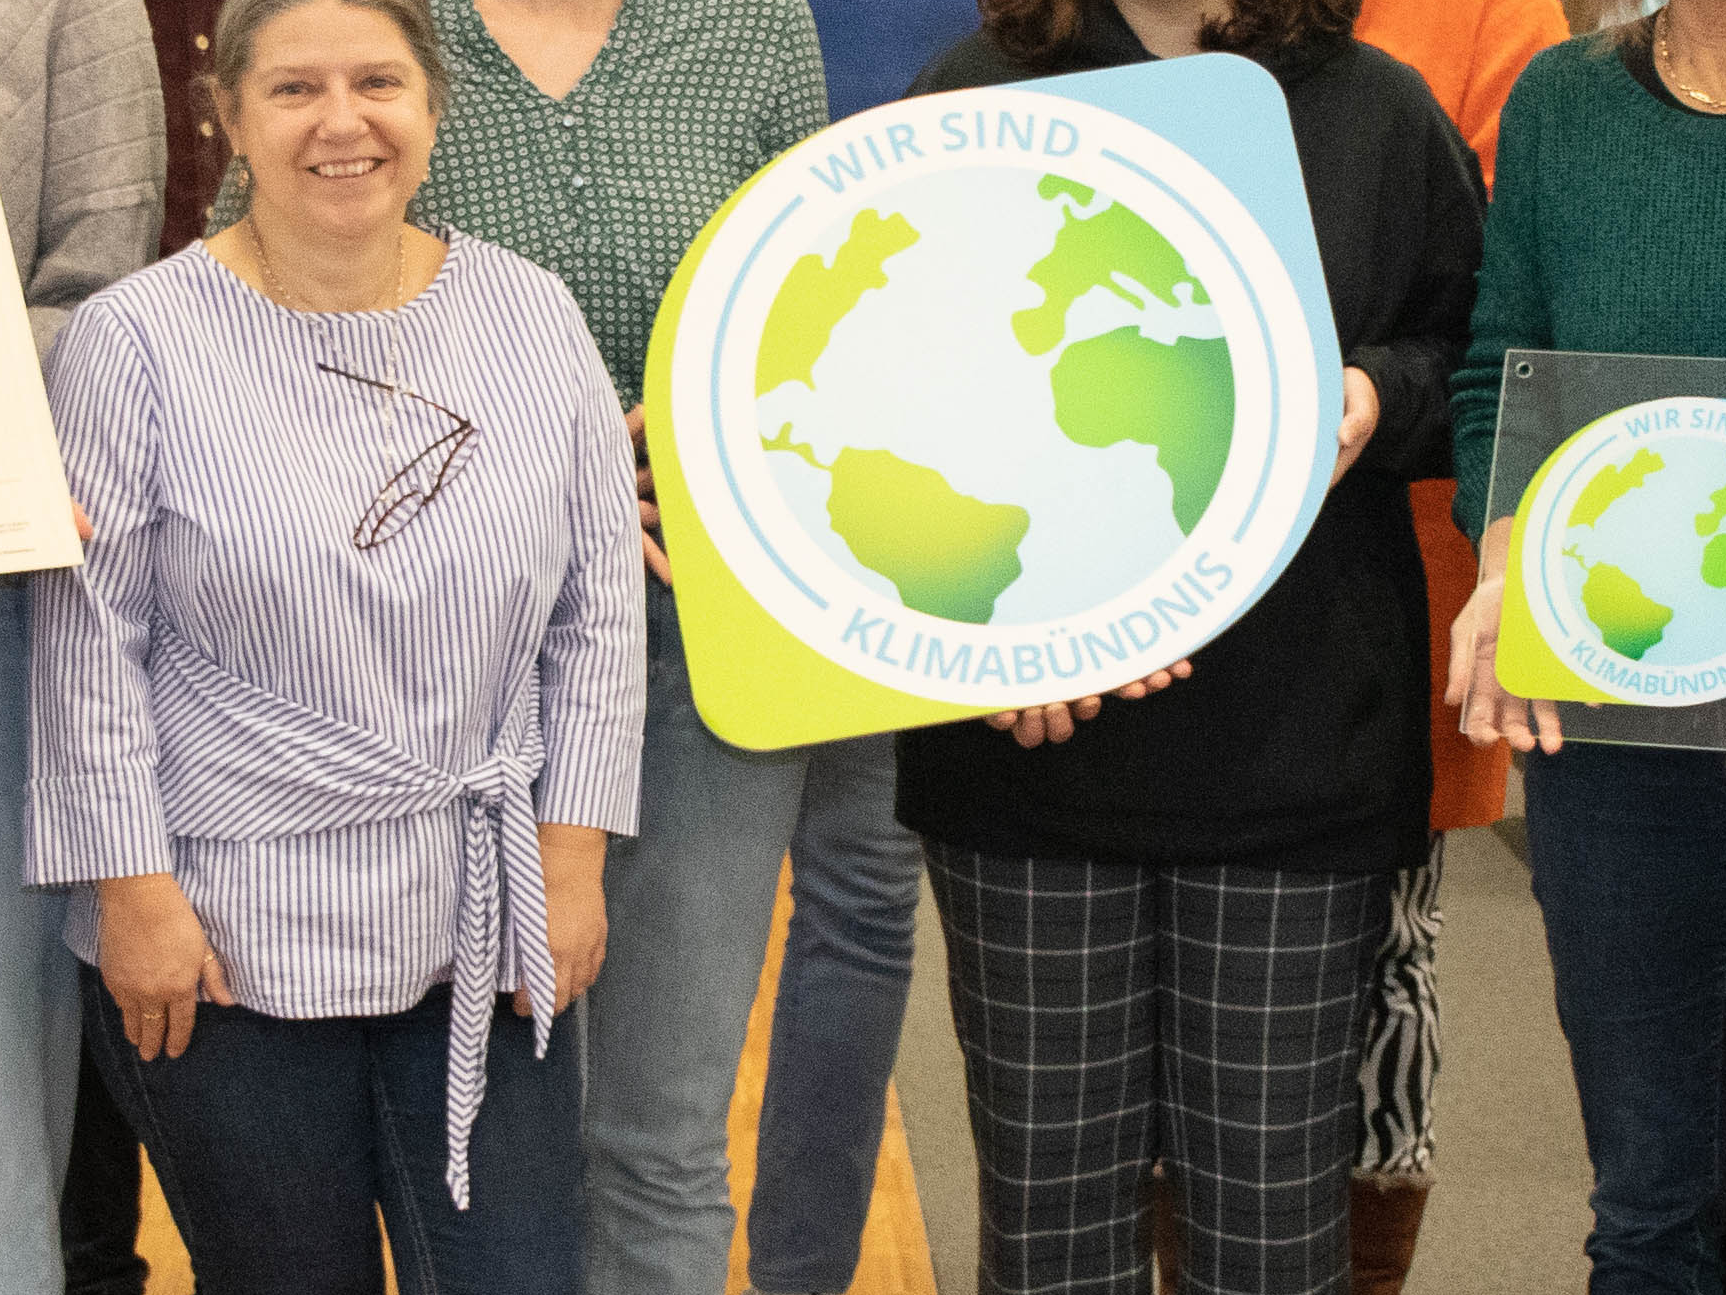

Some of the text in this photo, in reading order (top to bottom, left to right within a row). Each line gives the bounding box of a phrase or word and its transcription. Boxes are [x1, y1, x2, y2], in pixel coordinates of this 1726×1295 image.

[809, 111, 1081, 197] WIR SIND
[1624, 408, 1681, 438] WIR
[840, 551, 1235, 689] KLIMABÜNDNIS
